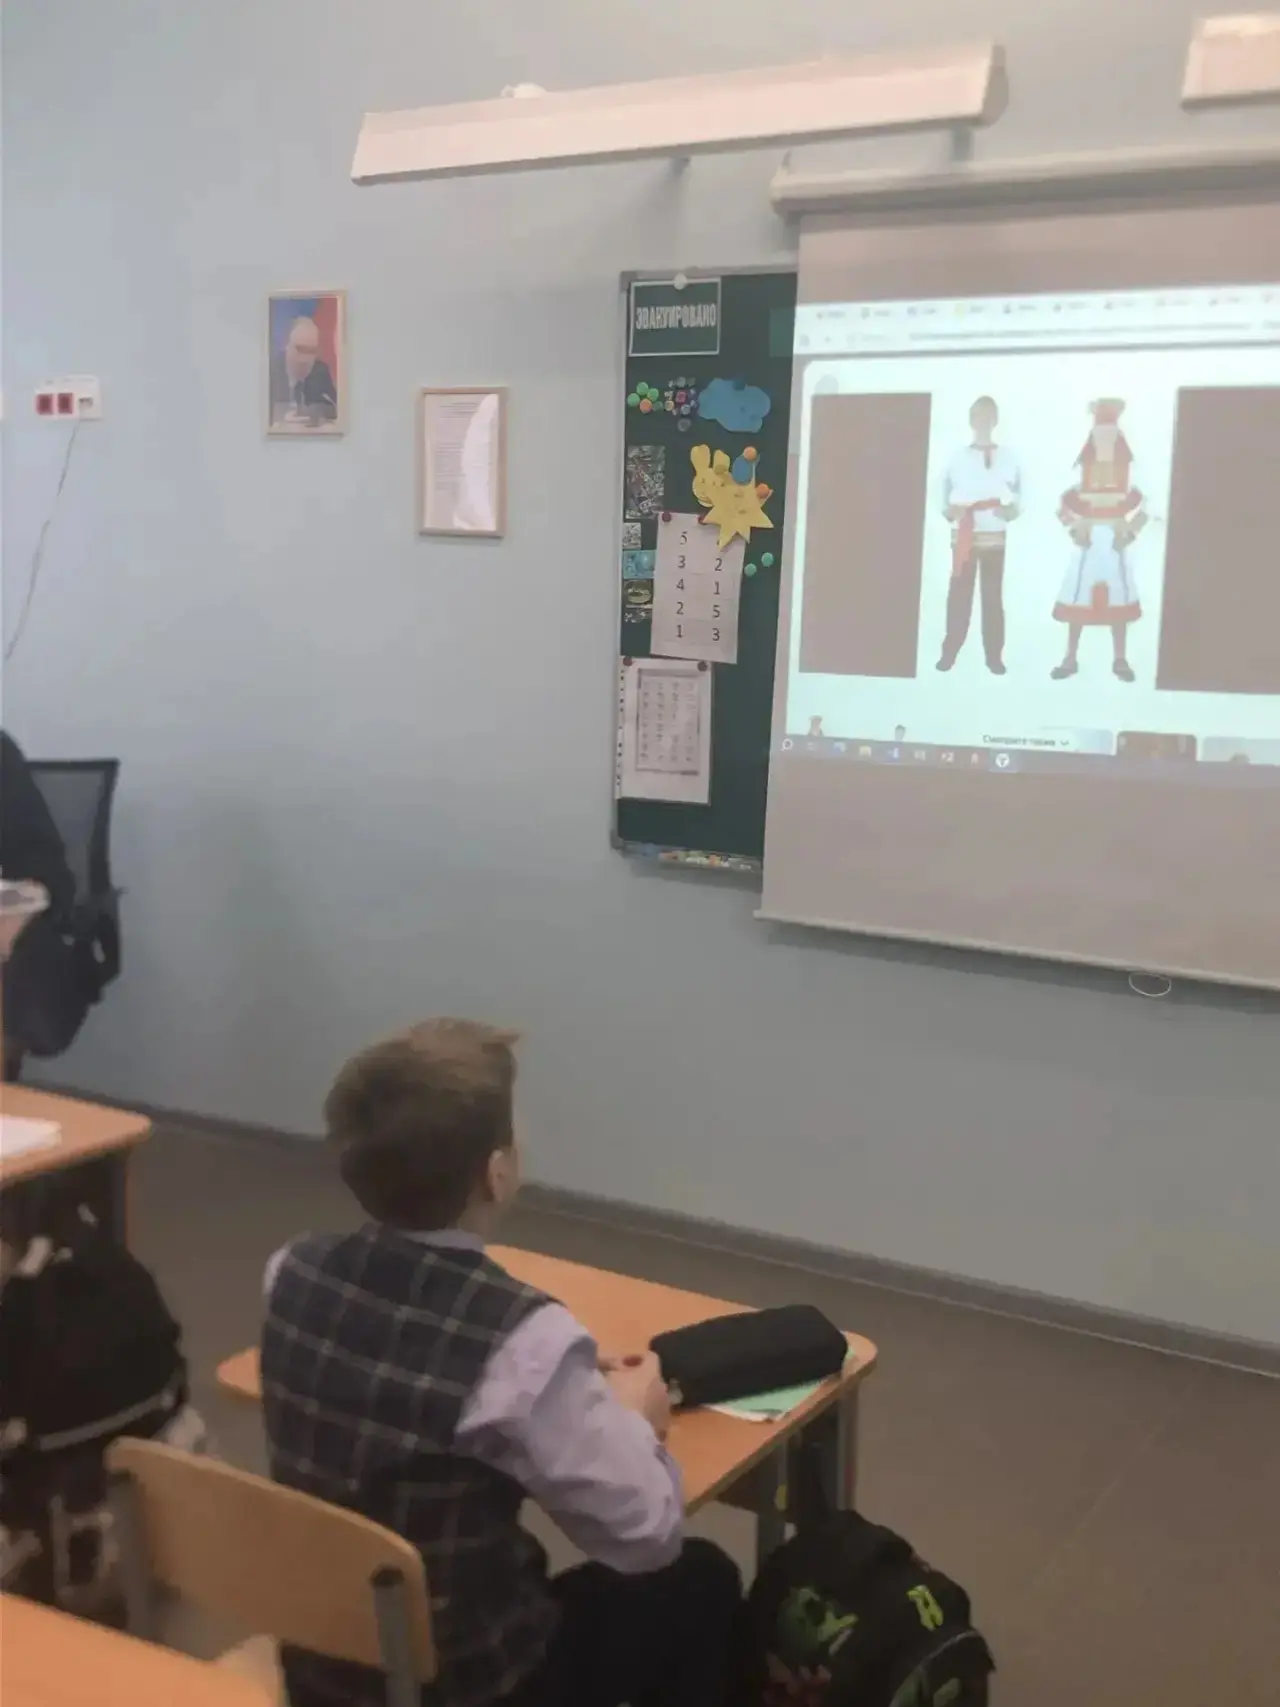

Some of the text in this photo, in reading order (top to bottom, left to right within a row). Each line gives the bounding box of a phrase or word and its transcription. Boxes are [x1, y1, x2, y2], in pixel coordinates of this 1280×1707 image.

[679, 531, 688, 545] 5
[677, 555, 723, 572] 3 2
[676, 578, 721, 595] 4 1
[676, 602, 721, 618] 2 5
[676, 625, 720, 642] 1 3
